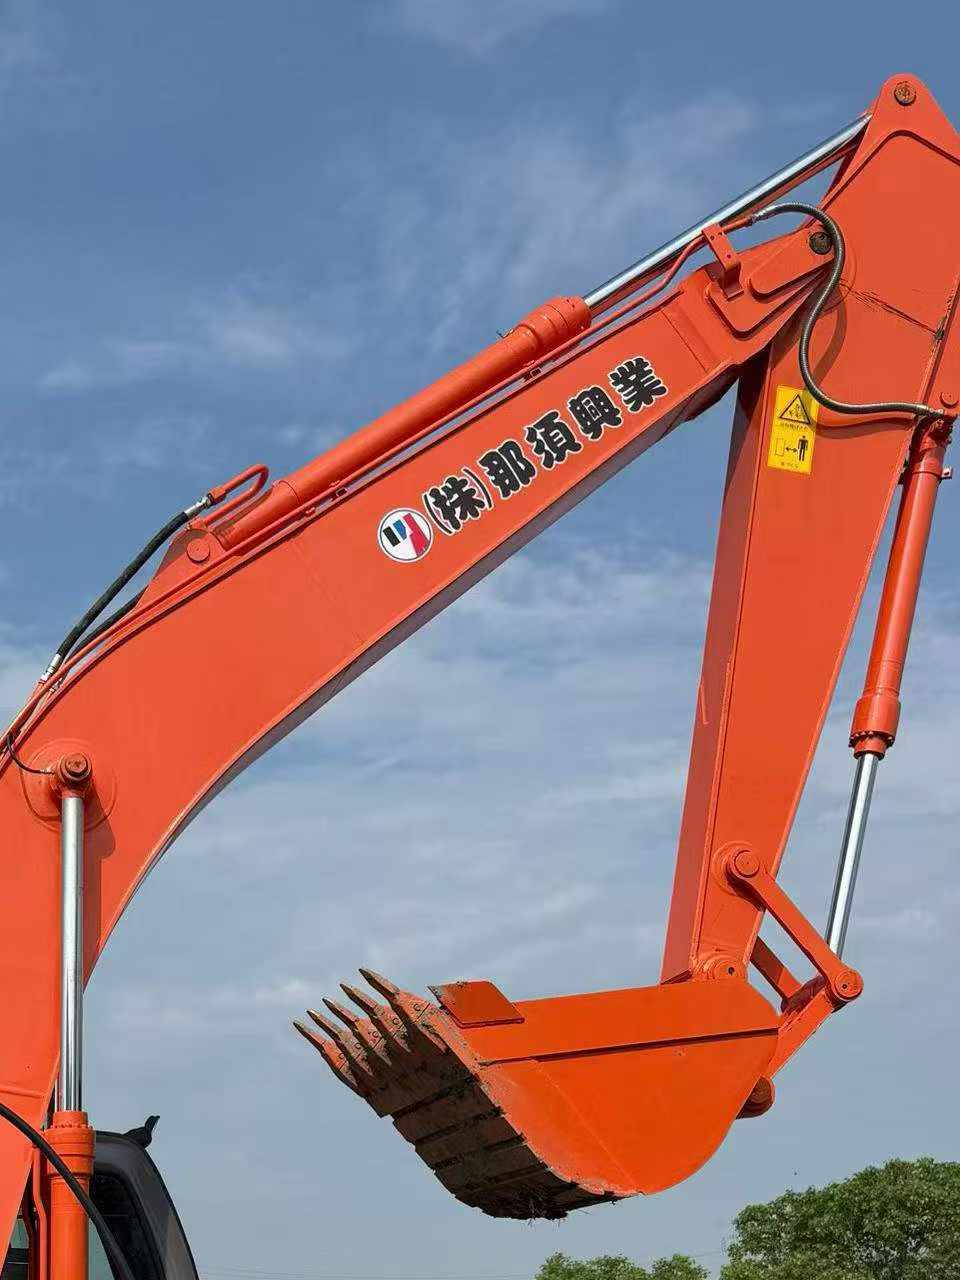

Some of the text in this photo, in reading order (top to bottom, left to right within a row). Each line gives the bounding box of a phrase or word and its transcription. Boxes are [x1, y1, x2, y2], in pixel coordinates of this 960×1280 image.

[423, 356, 666, 534] (株)那須興業
